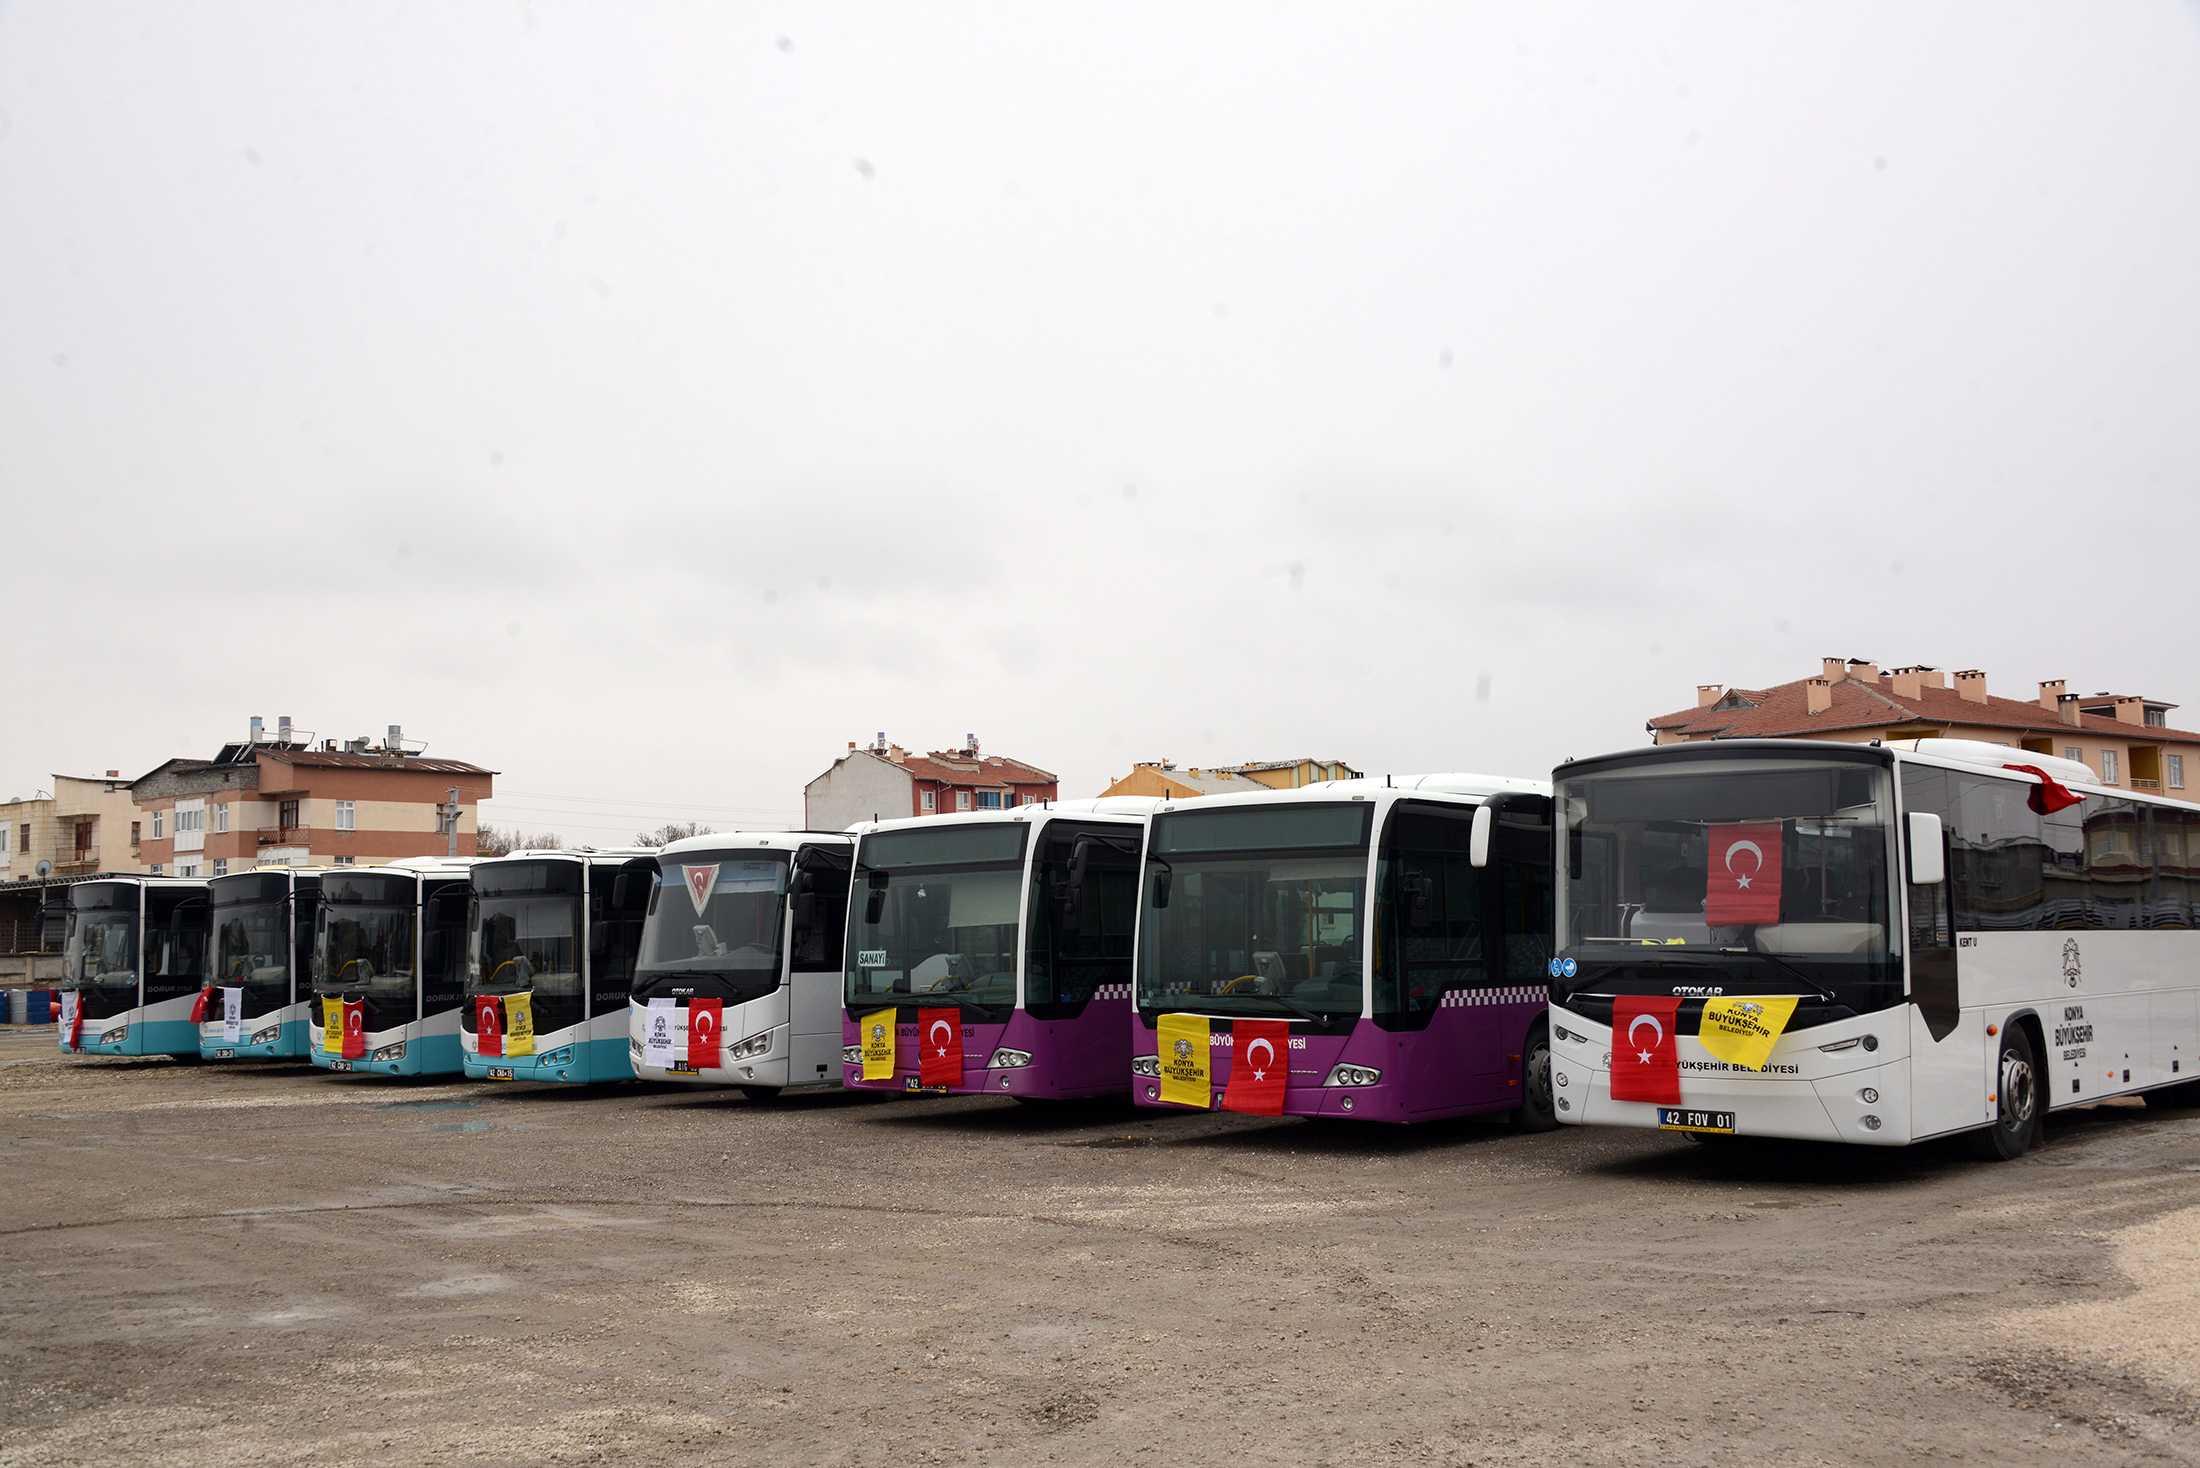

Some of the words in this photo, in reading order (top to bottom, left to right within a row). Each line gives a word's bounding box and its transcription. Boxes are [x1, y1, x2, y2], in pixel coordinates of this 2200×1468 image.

[1959, 937, 1972, 948] KENT
[147, 985, 176, 993] DORUK
[671, 987, 695, 995] OTOKAR
[1672, 986, 1723, 997] OTOKAR
[426, 993, 455, 1003] DORUK
[596, 992, 627, 1001] DORUK
[1727, 1008, 1758, 1022] KONYA
[2064, 1006, 2083, 1021] KONYA
[1708, 1011, 1770, 1038] BÜYÜKŞEHİR
[1173, 1059, 1194, 1067] KONYA
[1677, 1060, 1729, 1072] YÜKŞEHİR
[1732, 1062, 1799, 1074] BELDİYESİ
[1164, 1065, 1204, 1077] BÜYÜKŞEHİR
[910, 1078, 918, 1088] 42
[1666, 1111, 1680, 1125] 42
[1688, 1112, 1708, 1127] FOV
[1717, 1115, 1730, 1128] 01
